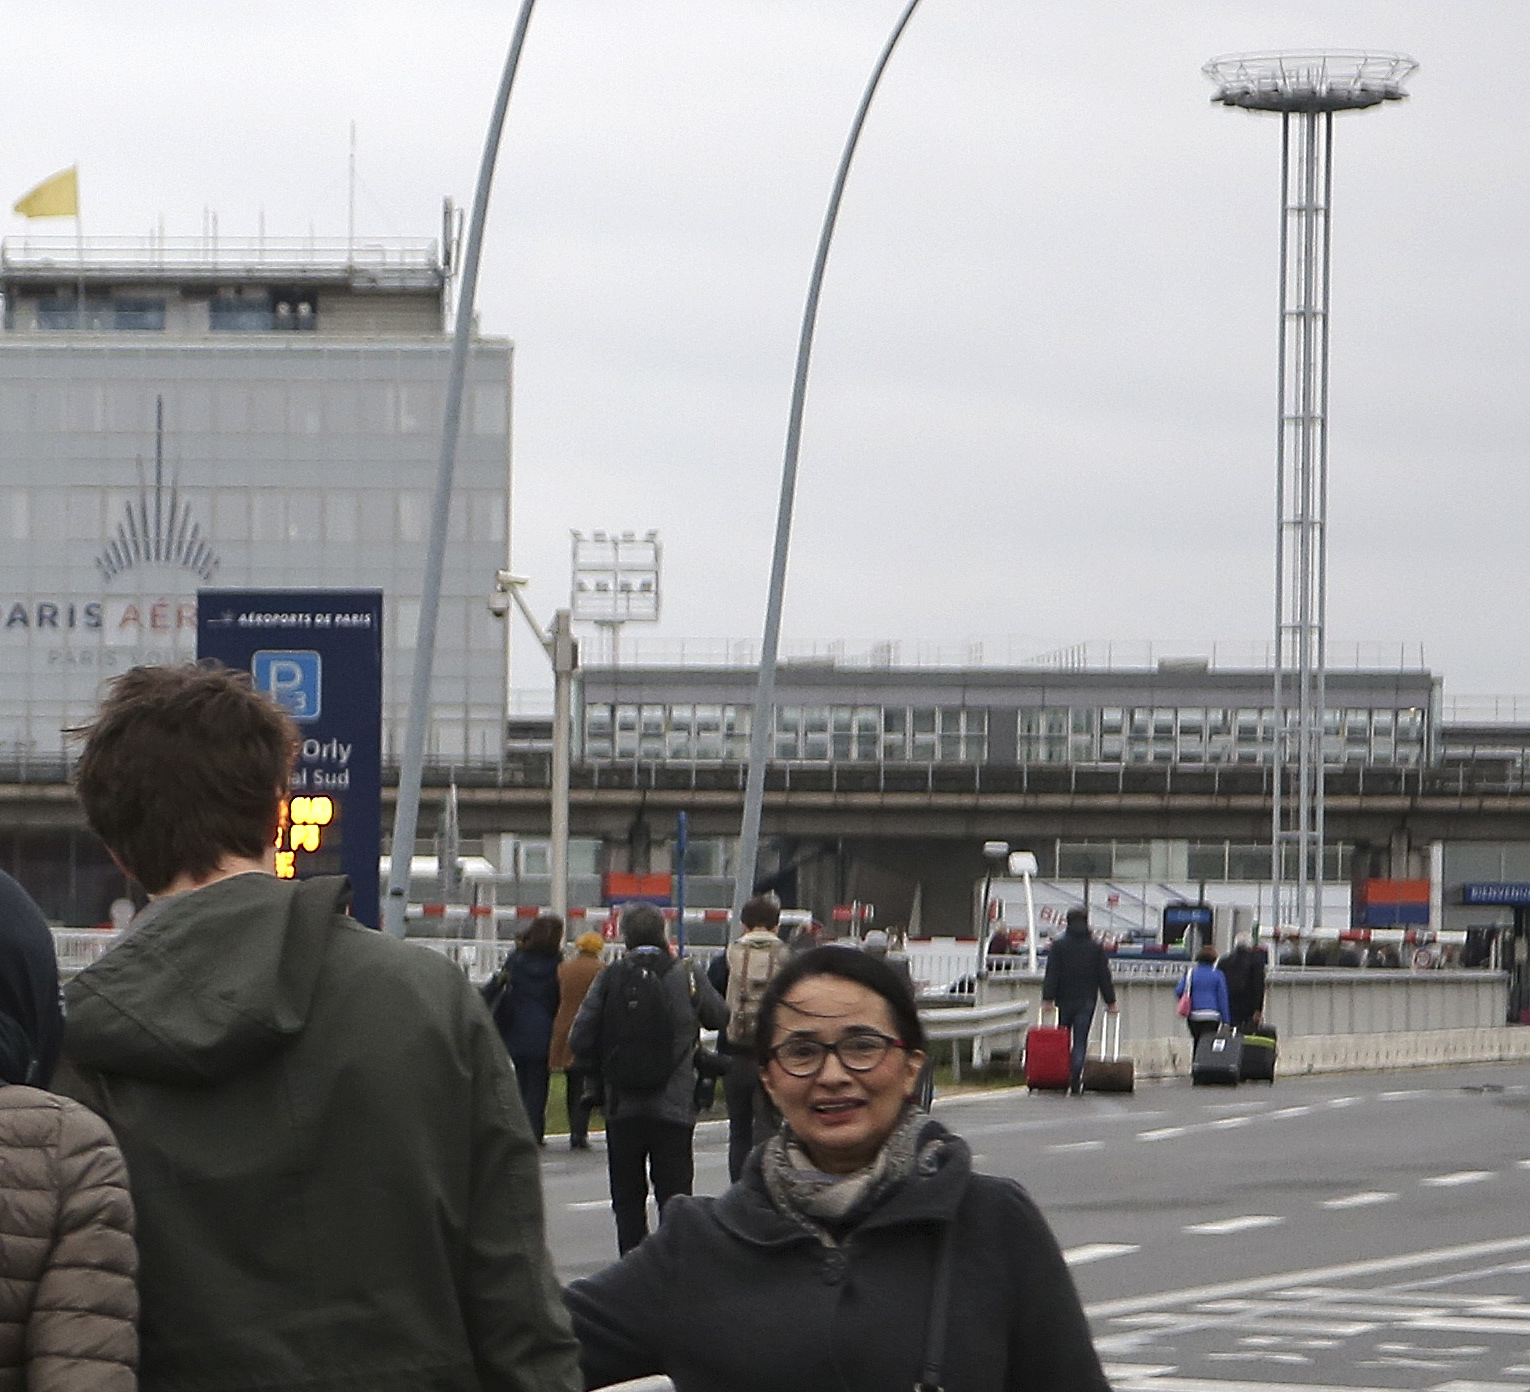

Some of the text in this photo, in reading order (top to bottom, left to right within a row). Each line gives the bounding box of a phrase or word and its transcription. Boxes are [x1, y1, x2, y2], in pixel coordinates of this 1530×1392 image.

[314, 613, 331, 626] DE
[334, 613, 371, 626] PARIS
[303, 738, 352, 765] Orly
[312, 767, 350, 785] Sud
